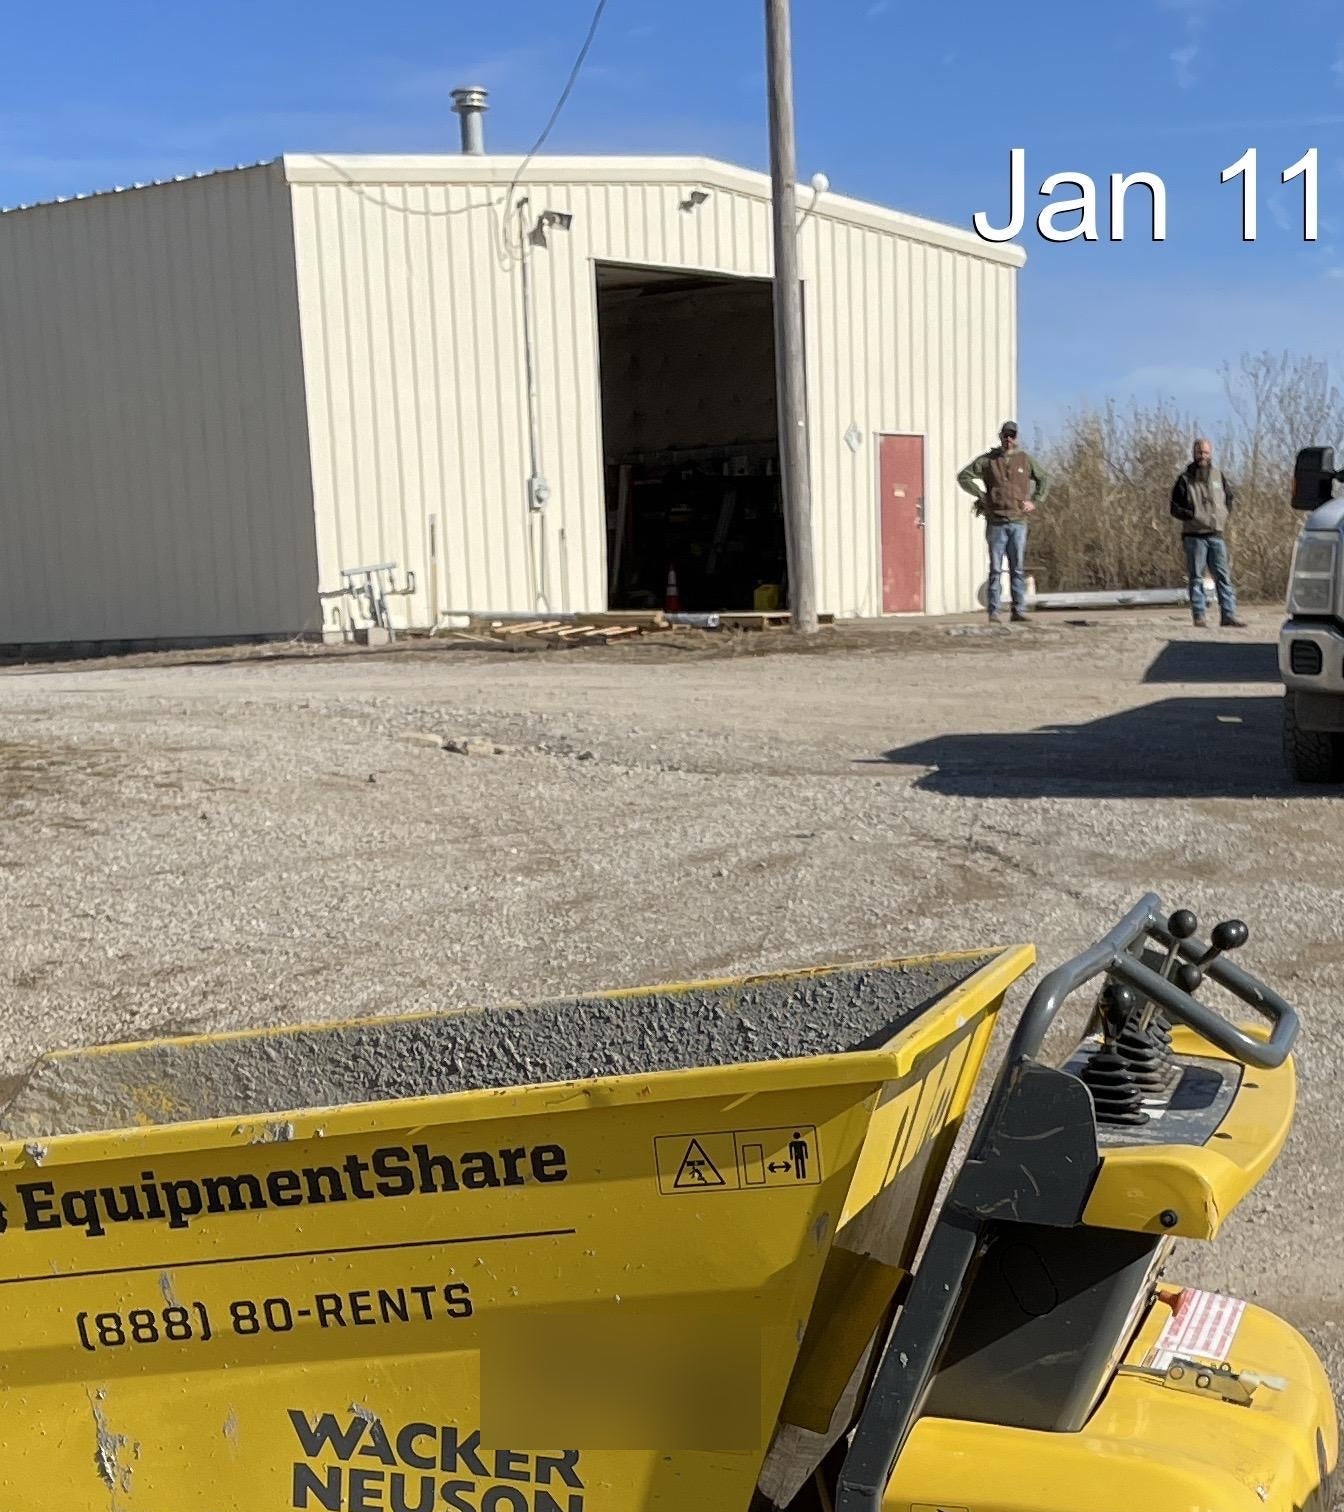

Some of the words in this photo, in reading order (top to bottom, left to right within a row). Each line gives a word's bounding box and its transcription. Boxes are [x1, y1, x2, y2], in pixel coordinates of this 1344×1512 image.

[16, 1143, 569, 1238] EquipmentShare
[76, 1301, 212, 1352] (888)
[229, 1282, 475, 1335] 80-RENTS
